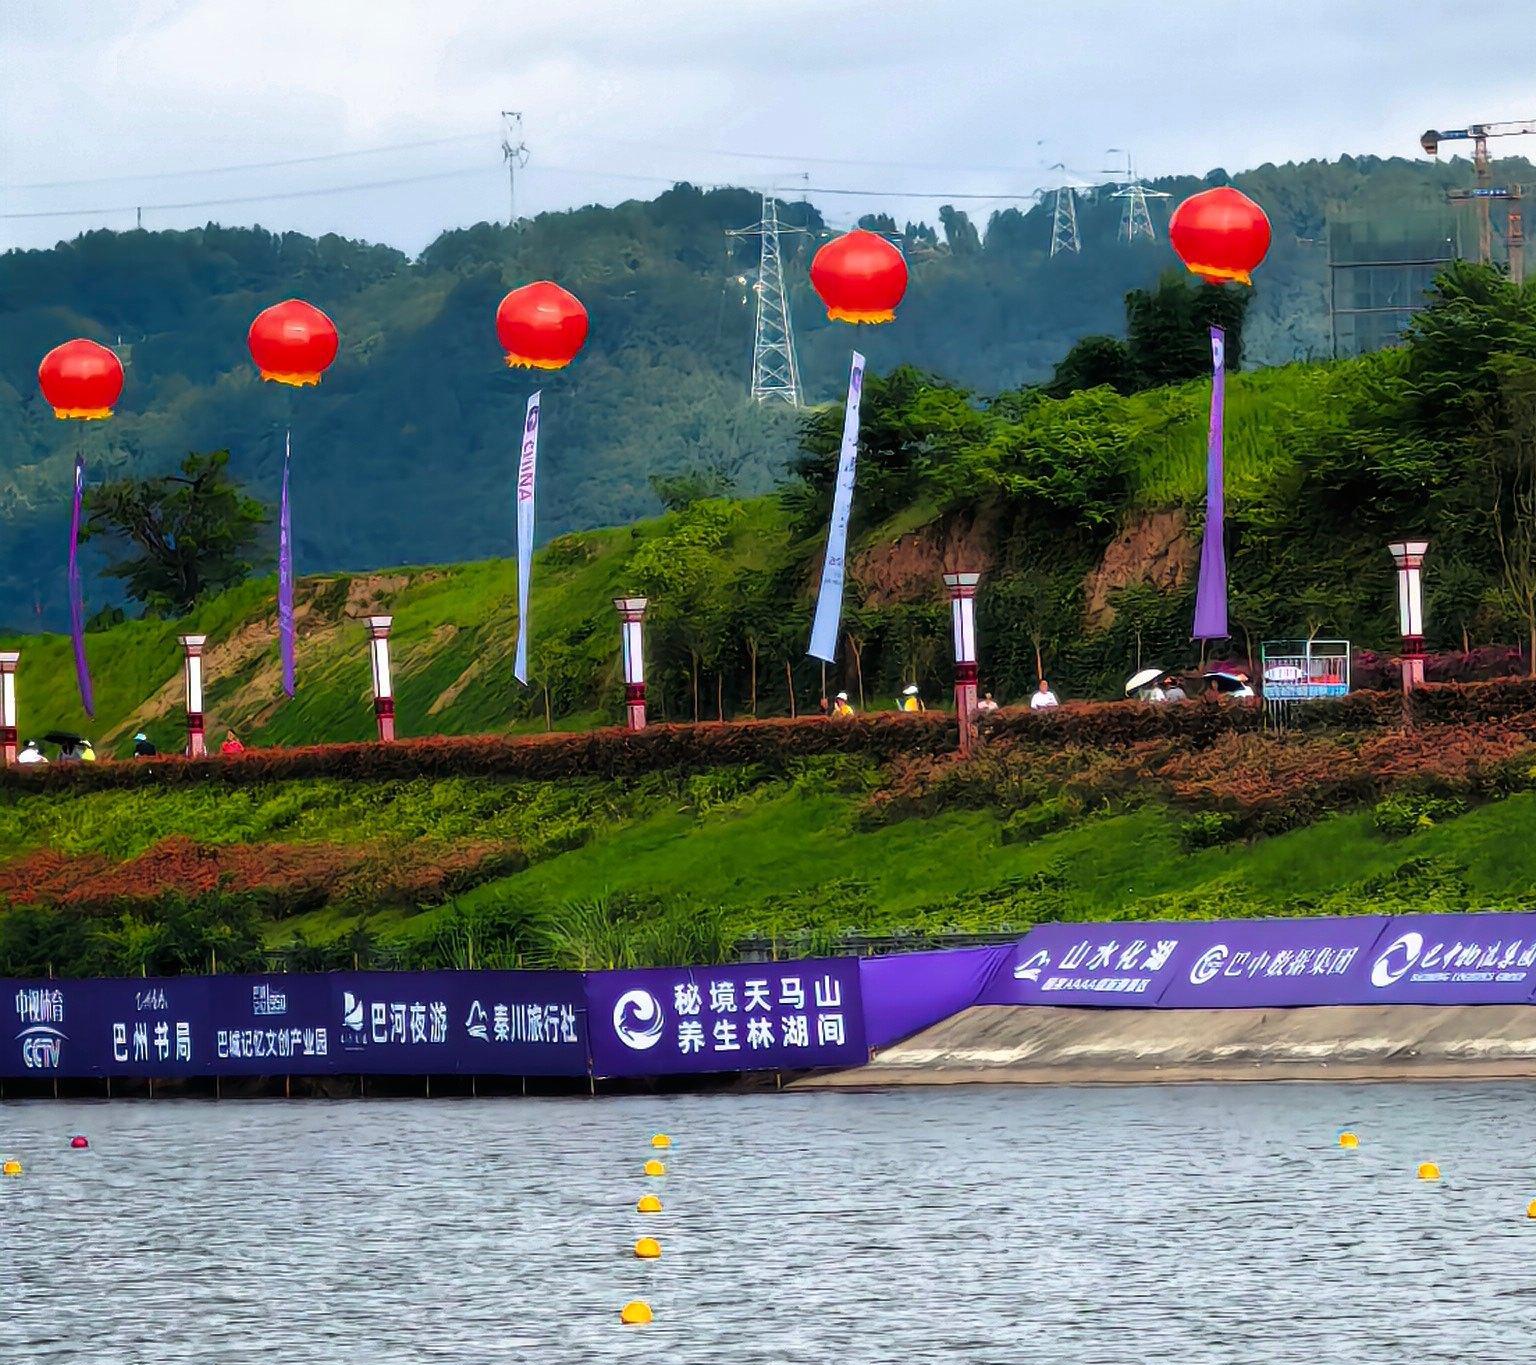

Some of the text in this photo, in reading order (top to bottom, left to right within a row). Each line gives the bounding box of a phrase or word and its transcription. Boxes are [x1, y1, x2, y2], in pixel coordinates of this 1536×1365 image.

[518, 439, 536, 502] CHINA
[1058, 940, 1178, 971] 山水化湖
[674, 974, 842, 1015] 秘境天马山
[113, 1021, 192, 1063] 巴州书局
[371, 1001, 447, 1043] 巴河夜游
[493, 1003, 578, 1043] 秦川旅行社
[677, 1013, 846, 1055] 养生林湖间
[23, 1037, 61, 1068] CCTV
